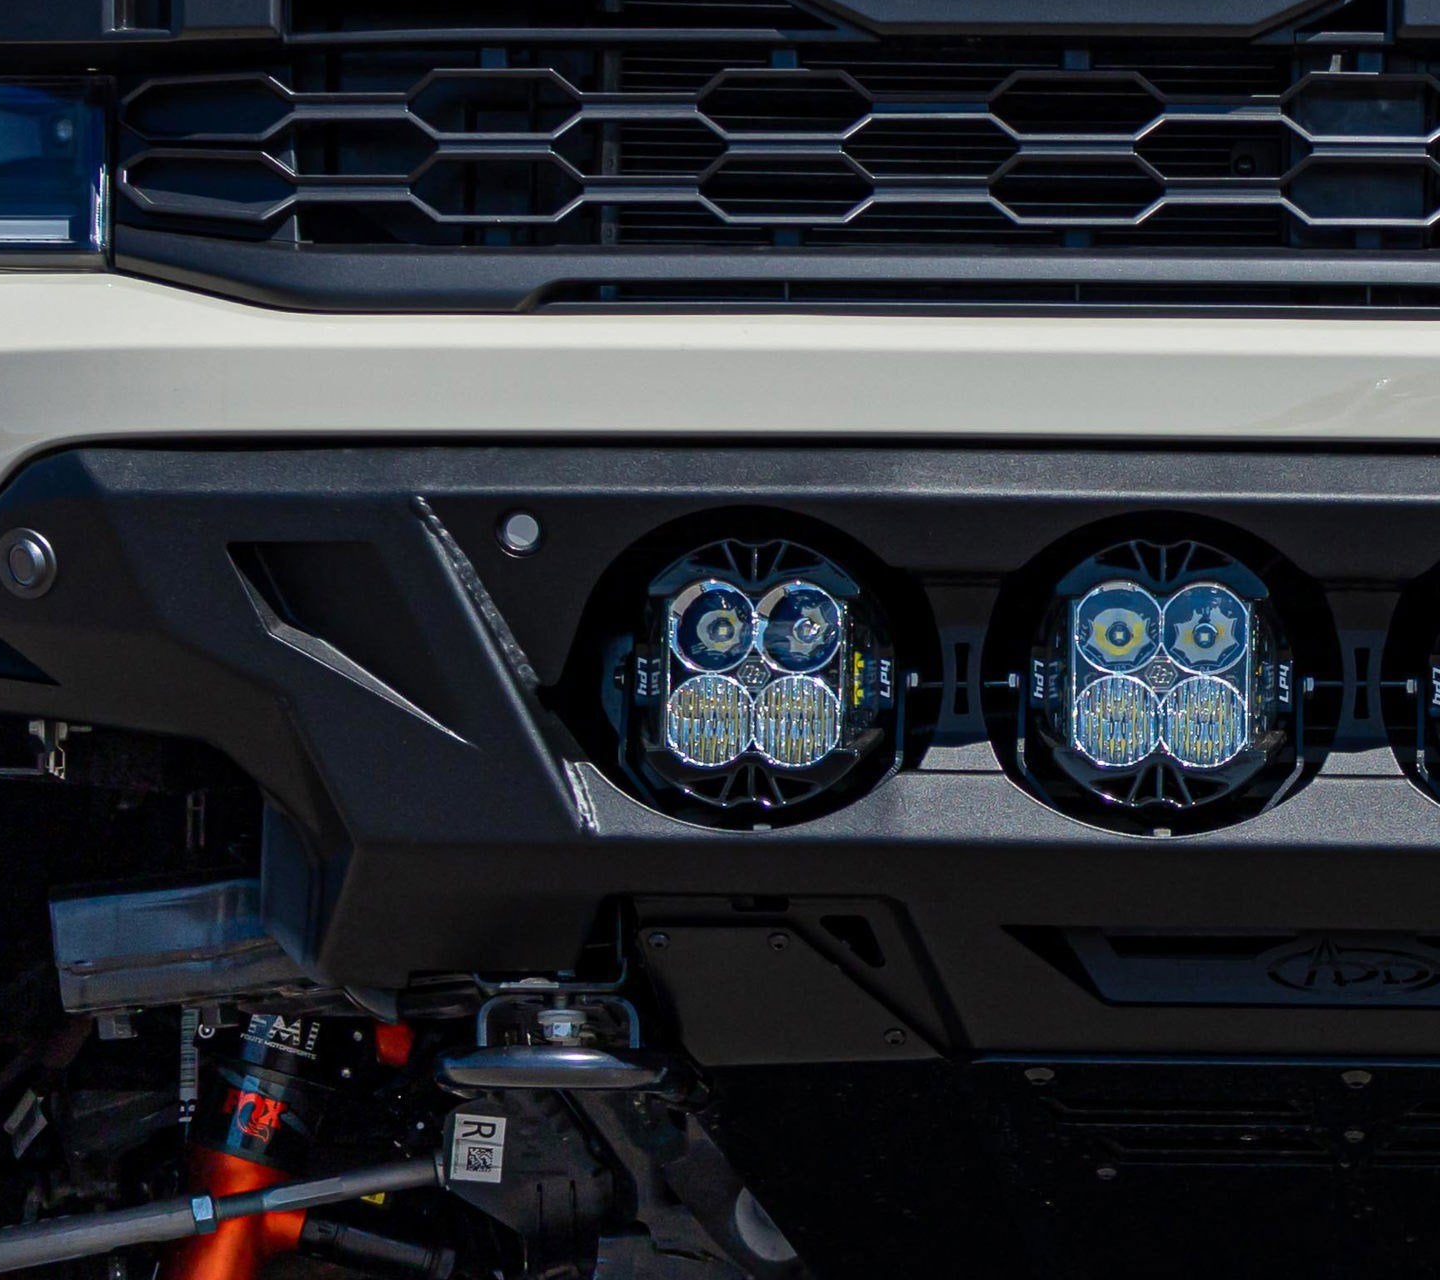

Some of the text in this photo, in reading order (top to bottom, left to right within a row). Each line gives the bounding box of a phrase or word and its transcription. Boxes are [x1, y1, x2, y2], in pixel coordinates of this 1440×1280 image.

[637, 656, 648, 697] LP4
[879, 659, 891, 699] LP4
[1033, 659, 1045, 700] LP4
[1278, 663, 1290, 704] LP4
[221, 1087, 288, 1141] FOX
[462, 1120, 496, 1138] R
